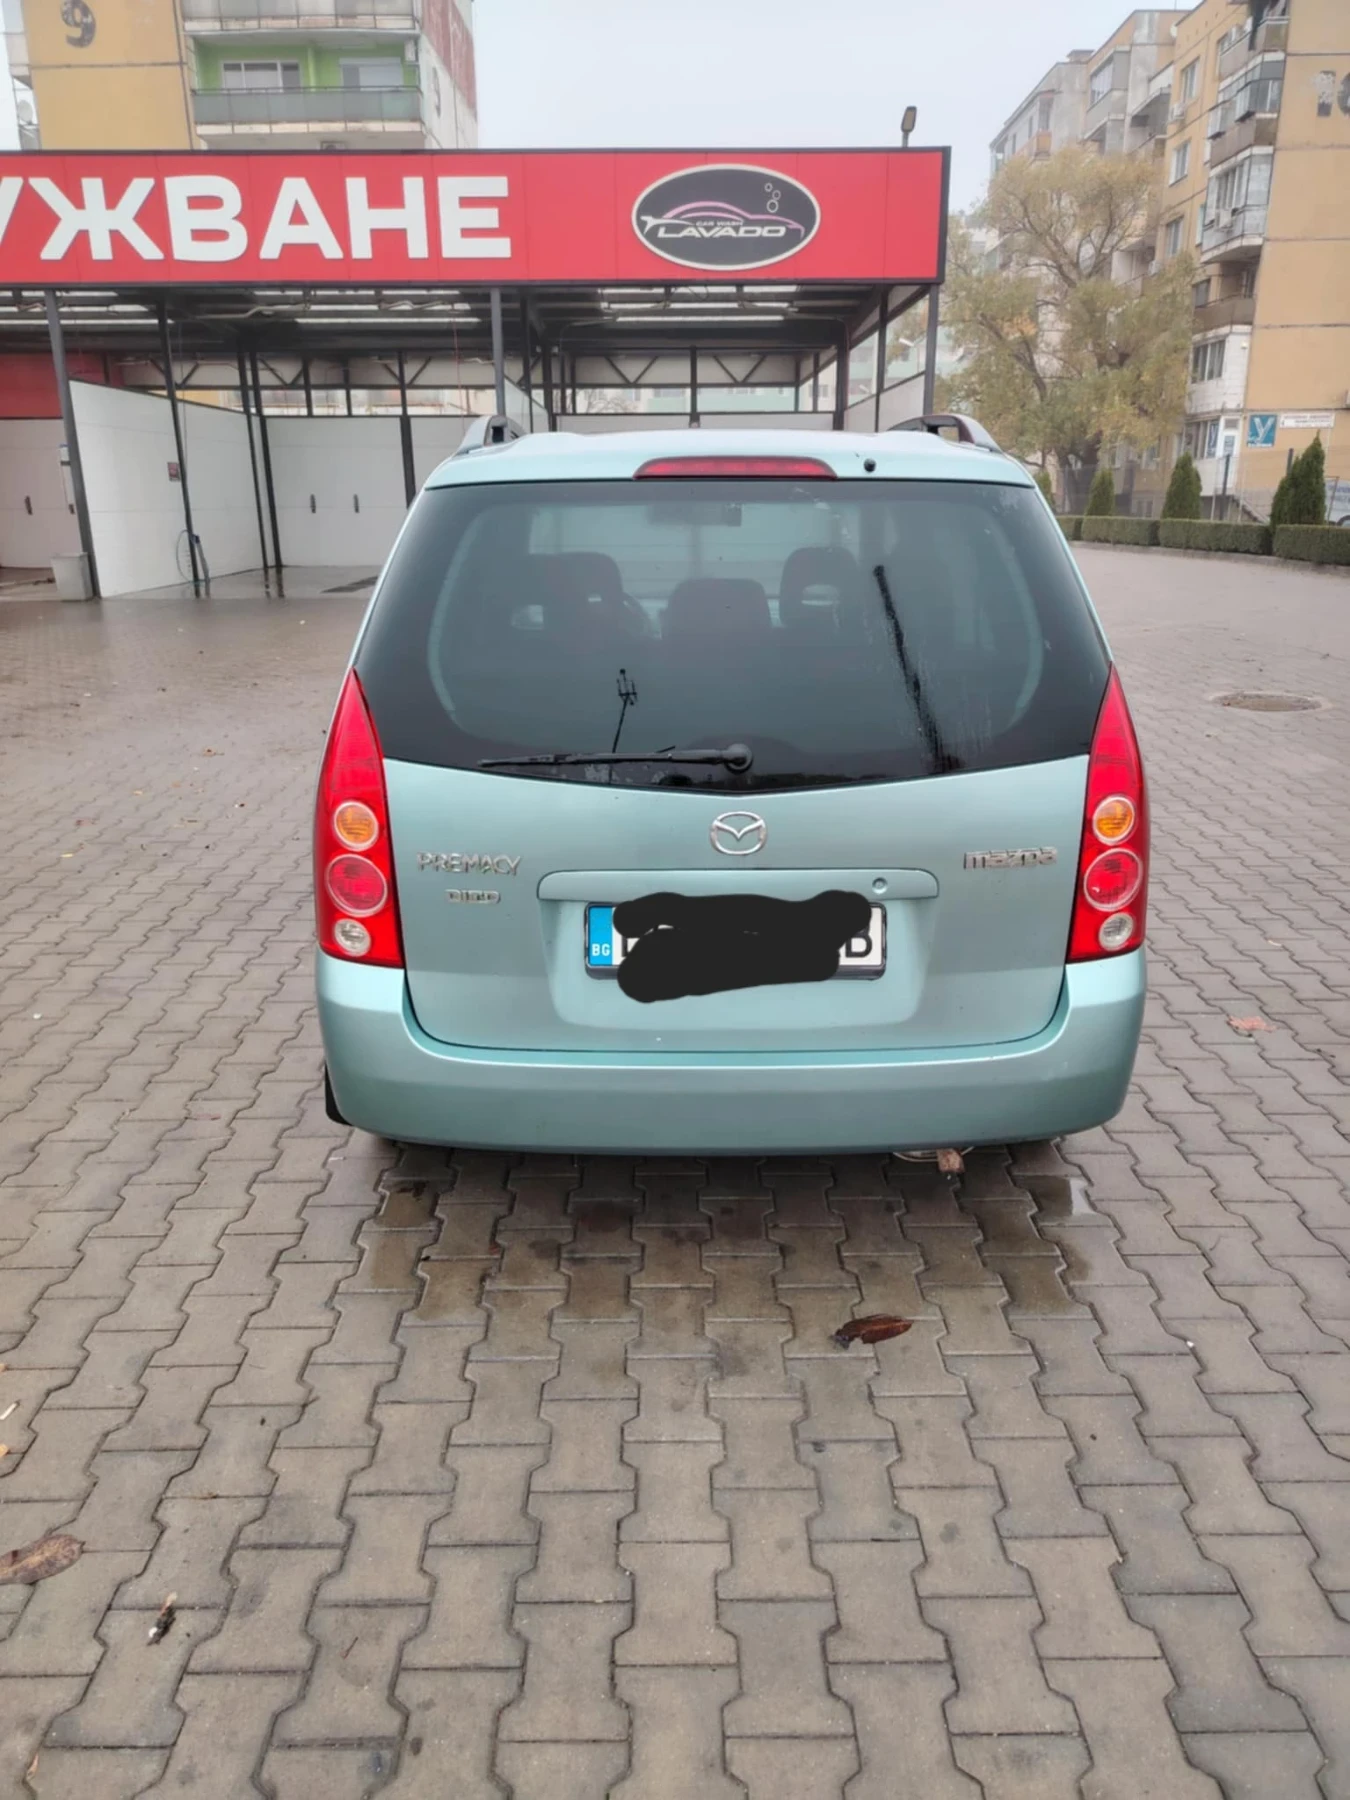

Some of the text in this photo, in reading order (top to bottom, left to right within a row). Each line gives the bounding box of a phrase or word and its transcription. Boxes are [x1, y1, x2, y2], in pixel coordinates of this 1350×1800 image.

[60, 0, 96, 48] 9
[657, 226, 786, 238] LAVADO
[417, 852, 521, 876] PREMACY
[591, 943, 611, 957] BG
